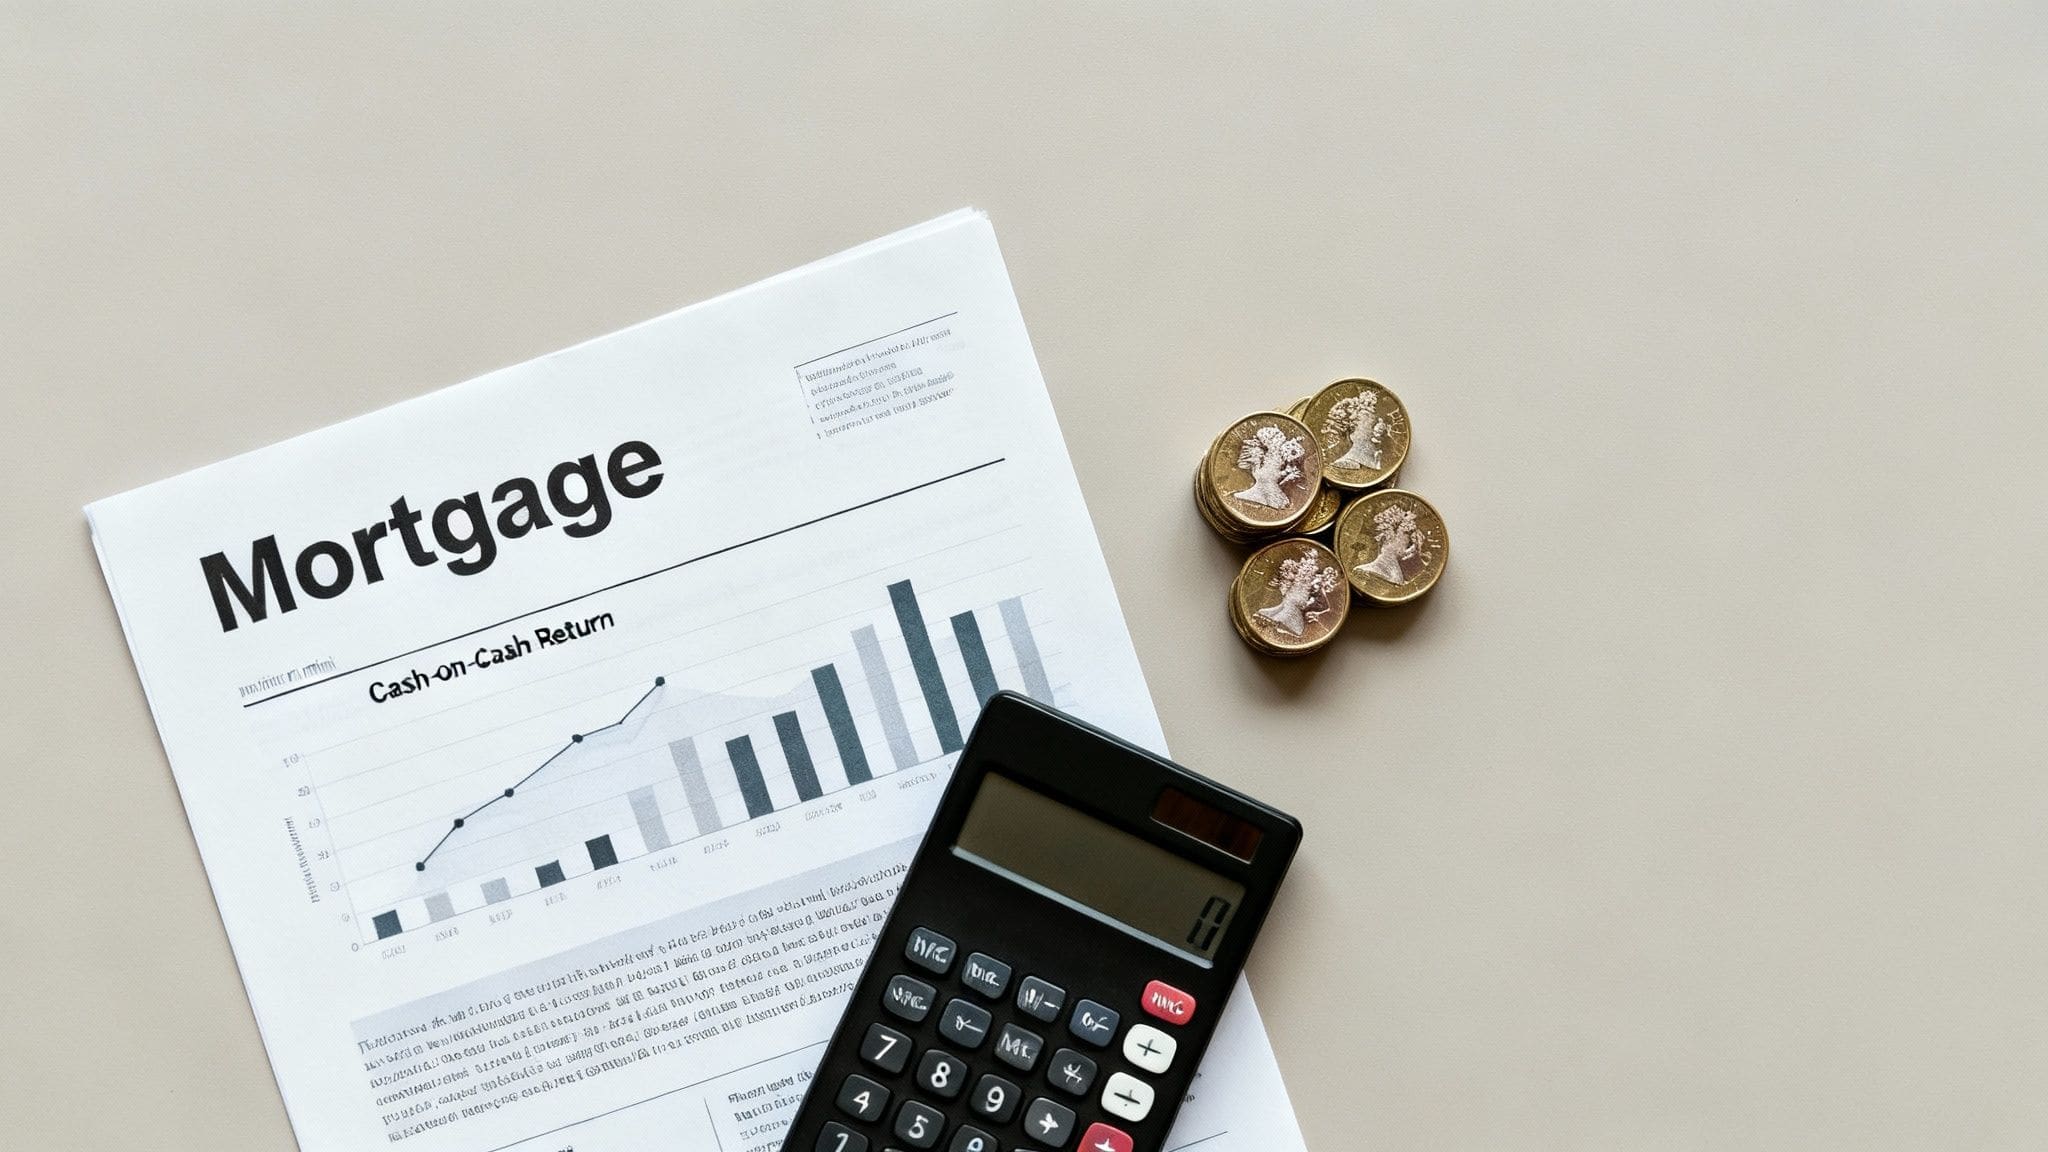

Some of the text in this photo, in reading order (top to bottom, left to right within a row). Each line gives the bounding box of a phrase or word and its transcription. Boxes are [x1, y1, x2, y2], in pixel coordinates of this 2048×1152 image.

[200, 440, 665, 633] Mortgage
[369, 635, 532, 703] Cash-on-Cash
[534, 612, 615, 649] Return
[874, 1034, 898, 1060] 7
[930, 1061, 951, 1088] 8
[853, 1091, 870, 1114] 4
[985, 1086, 1005, 1113] 9
[908, 1114, 929, 1139] 5
